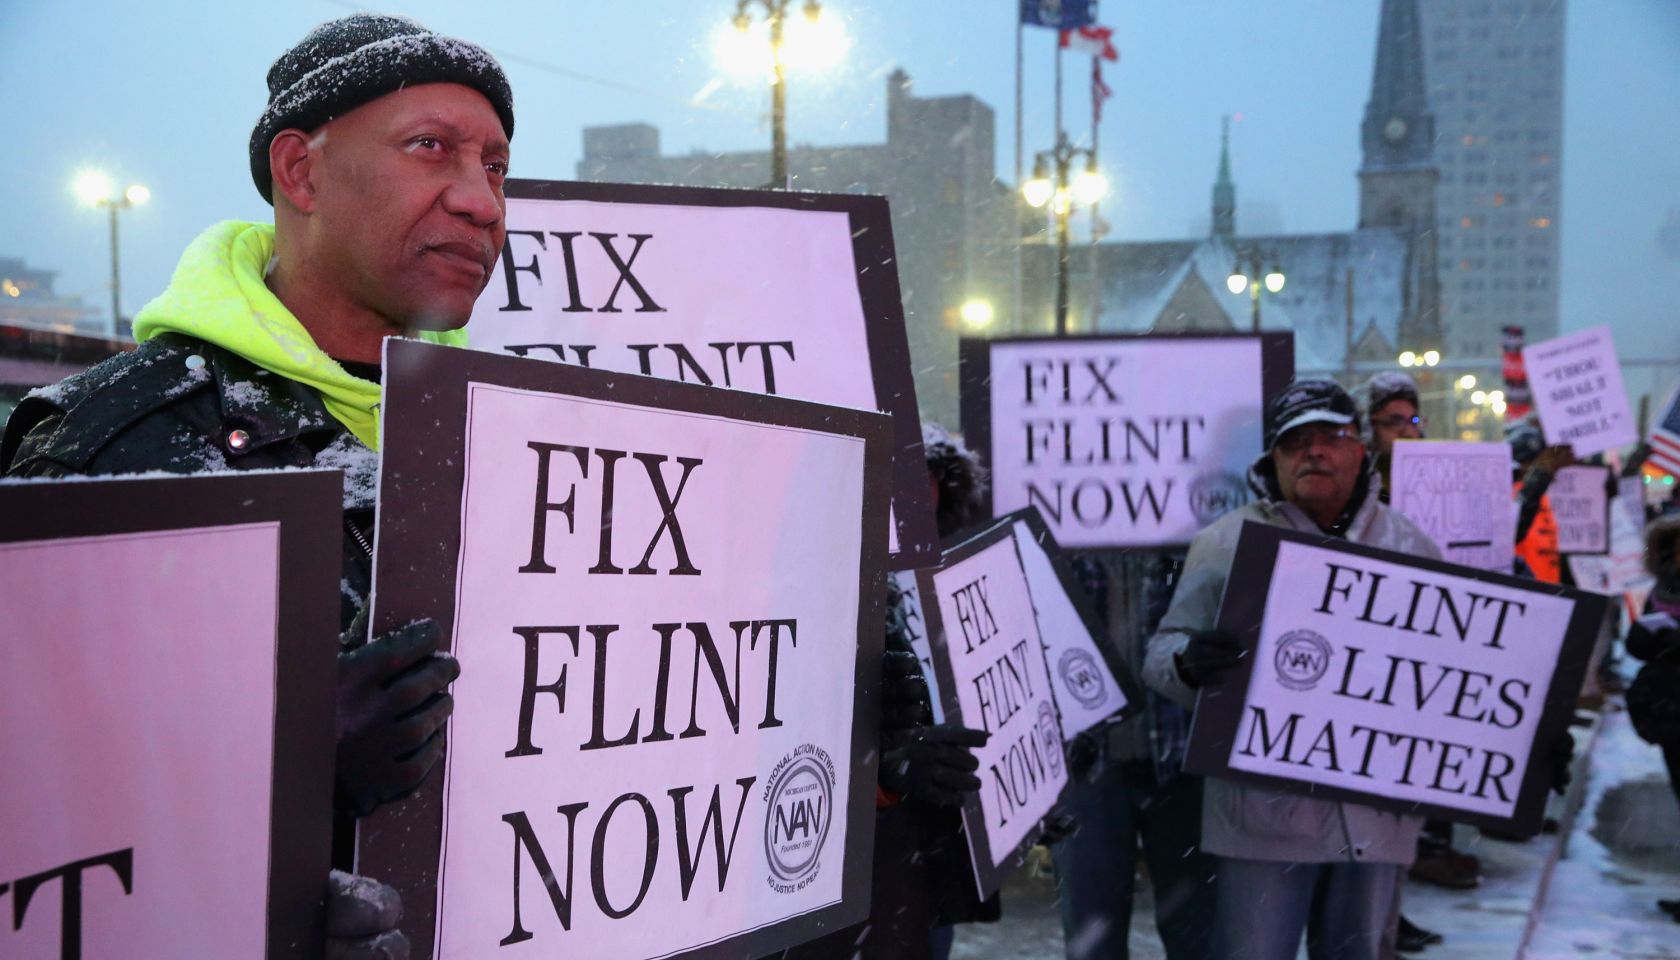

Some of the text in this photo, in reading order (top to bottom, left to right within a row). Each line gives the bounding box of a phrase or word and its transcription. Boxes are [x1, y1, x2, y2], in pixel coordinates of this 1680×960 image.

[499, 230, 667, 313] FIX
[1021, 358, 1122, 406] FIX
[1021, 414, 1206, 466] FLINT
[518, 440, 703, 576] FIX
[1022, 477, 1177, 528] NOW
[951, 575, 999, 655] FIX
[1313, 562, 1527, 650] FLINT
[505, 618, 797, 758] FLINT
[972, 639, 1034, 740] FLINT
[1333, 646, 1531, 730] LIVES
[762, 743, 836, 802] NATIONAL ACTION NETWORK
[990, 724, 1046, 828] NOW
[1238, 705, 1517, 803] MATTER
[500, 775, 756, 947] NOW
[774, 795, 822, 845] NAN
[780, 842, 801, 854] Founded
[766, 874, 775, 888] NO
[774, 883, 796, 894] JUSTICE
[796, 880, 806, 891] NO
